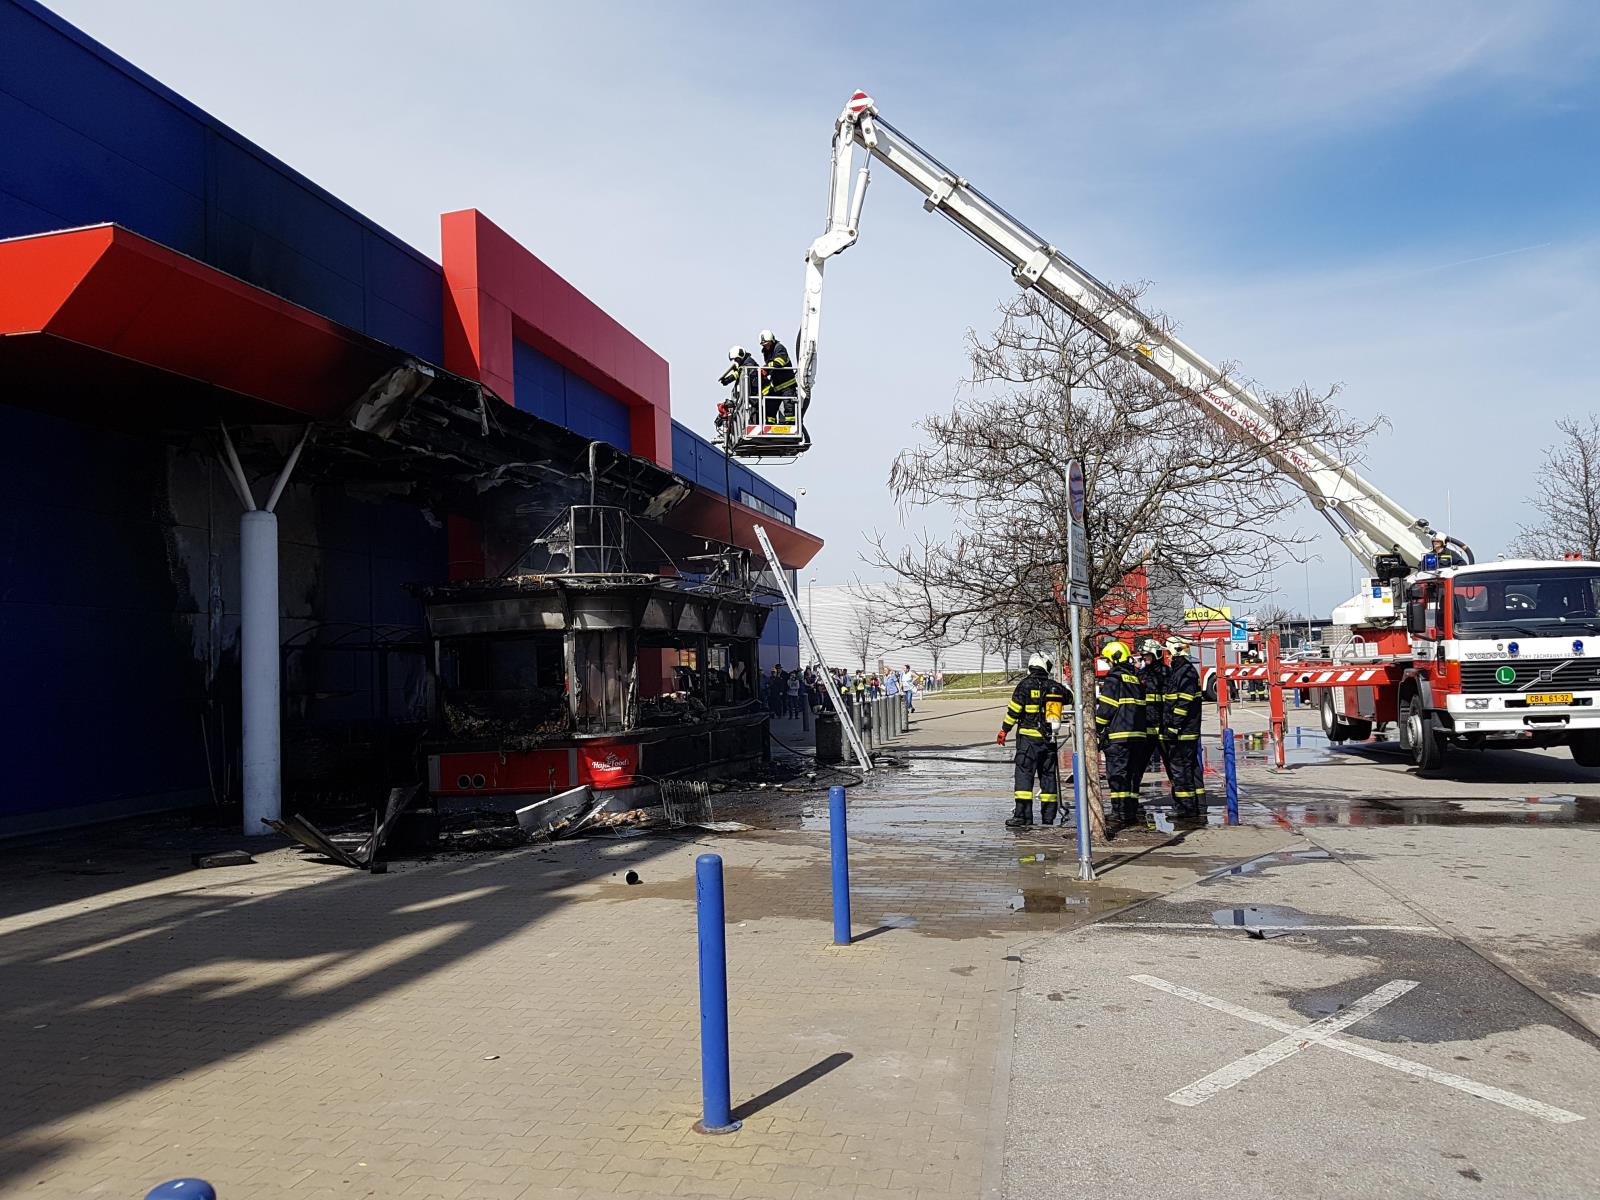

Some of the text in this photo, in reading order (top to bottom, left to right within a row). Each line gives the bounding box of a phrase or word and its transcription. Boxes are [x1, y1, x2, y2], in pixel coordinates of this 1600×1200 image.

[1203, 389, 1238, 417] BRONTO
[1465, 652, 1507, 660] VOLVO
[1530, 694, 1569, 703] CBA 61-32
